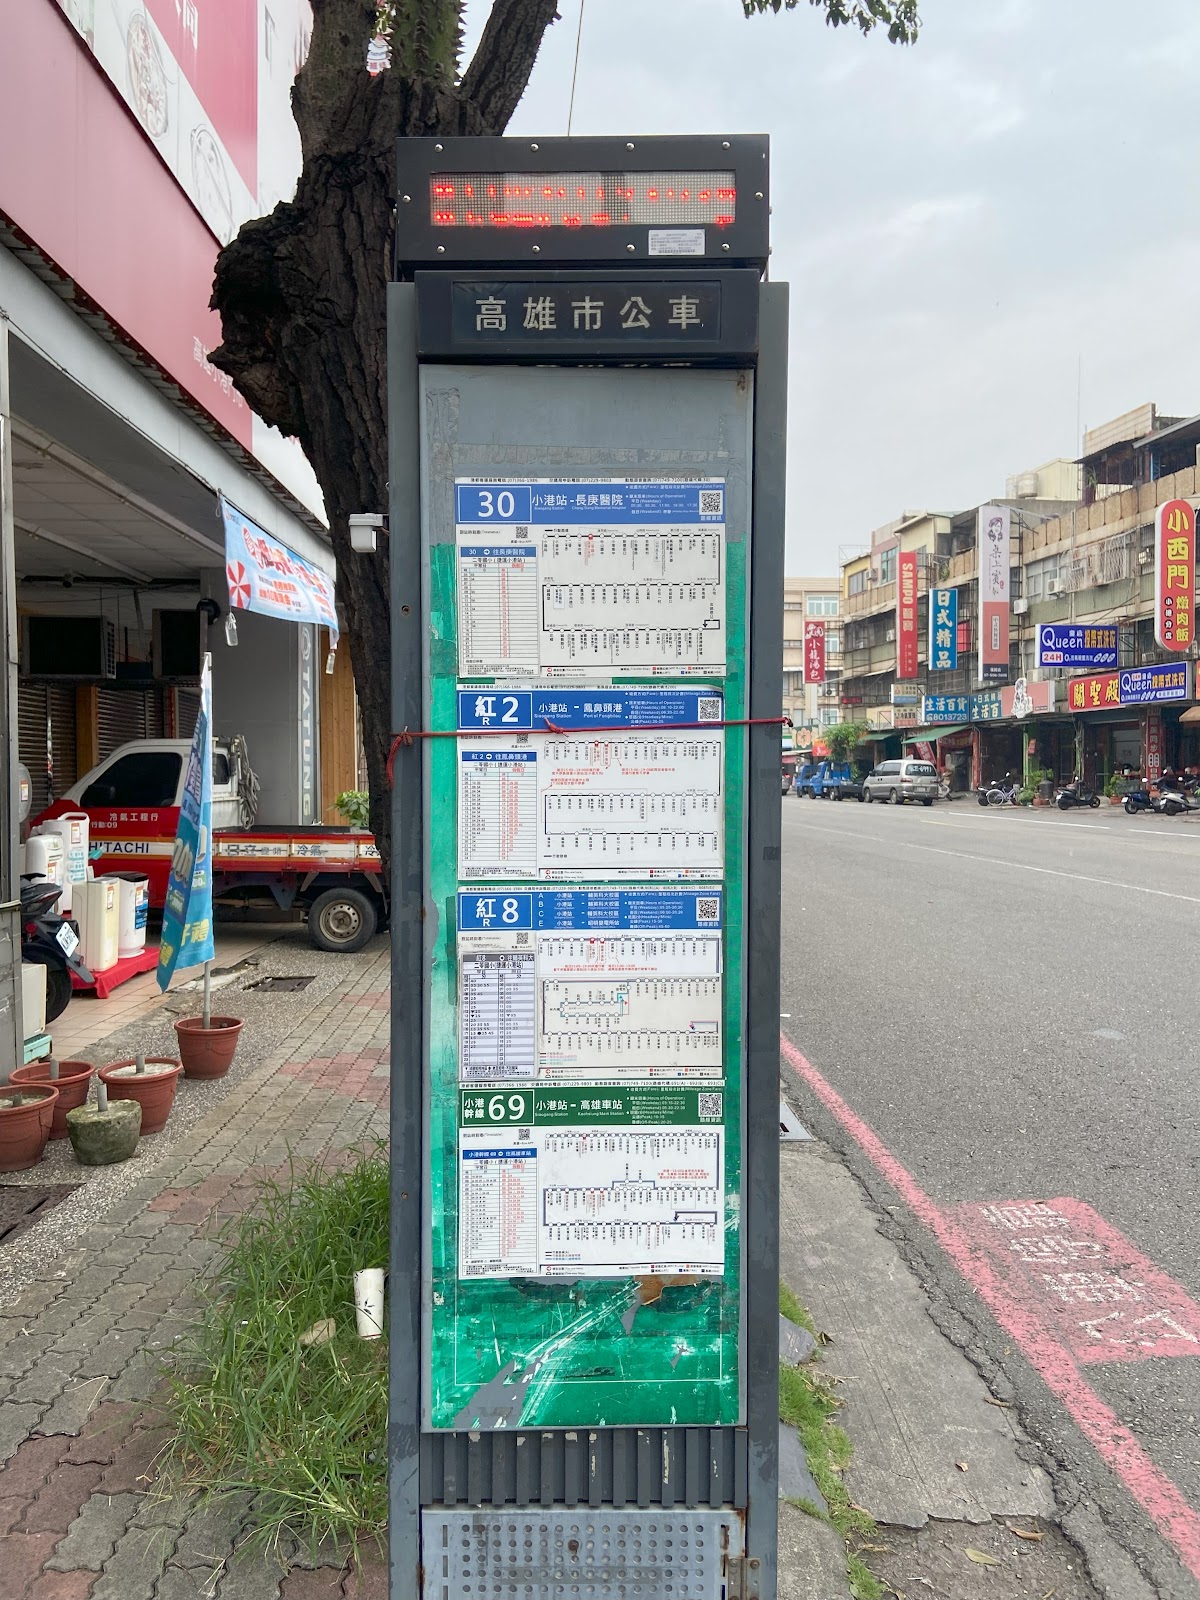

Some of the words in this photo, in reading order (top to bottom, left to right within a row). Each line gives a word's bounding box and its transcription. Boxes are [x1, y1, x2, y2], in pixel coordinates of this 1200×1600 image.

[476, 296, 701, 331] 高雄市公車
[478, 491, 515, 518] 30
[1167, 508, 1189, 590] 小西門
[902, 563, 913, 604] SAMPO
[936, 591, 952, 668] 日式精品
[1042, 628, 1082, 650] Queen
[1084, 630, 1116, 648] 投幣式洗衣
[809, 640, 820, 680] 小龍湯包
[1122, 674, 1150, 693] Queen
[926, 698, 968, 712] 生活百貨
[972, 703, 999, 720] 生活百
[482, 717, 490, 726] R
[302, 670, 310, 816] TATUNG
[110, 812, 158, 822] 冷氣工程行
[483, 918, 490, 926] R
[464, 1098, 484, 1108] 小港
[488, 1095, 525, 1120] 69
[580, 1099, 622, 1110] 高雄車站
[464, 1108, 484, 1119] 幹線
